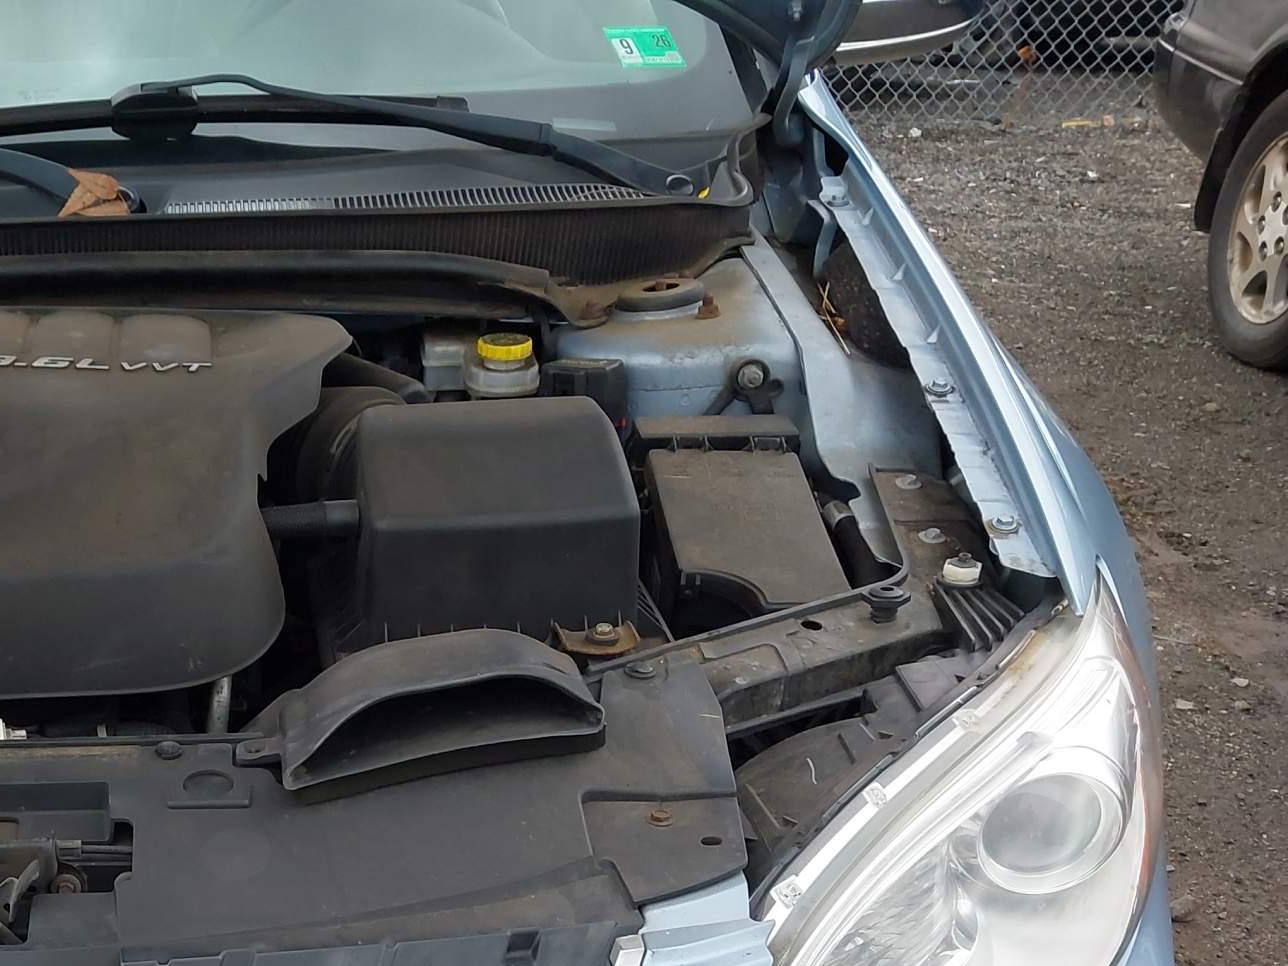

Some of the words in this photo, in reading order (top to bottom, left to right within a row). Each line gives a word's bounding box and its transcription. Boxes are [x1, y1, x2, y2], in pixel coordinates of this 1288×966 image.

[619, 38, 634, 56] 9
[652, 34, 672, 49] 26
[120, 361, 213, 373] VVT
